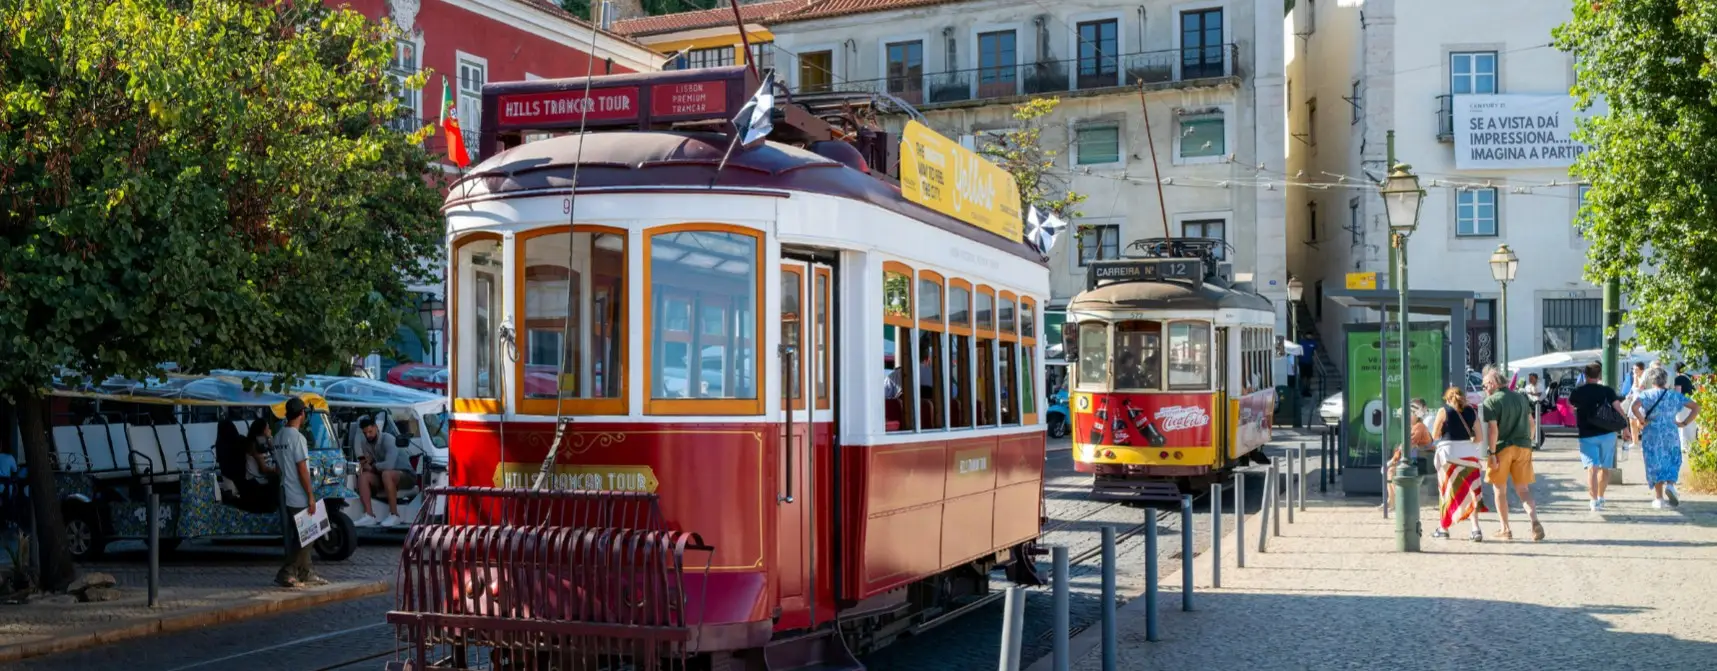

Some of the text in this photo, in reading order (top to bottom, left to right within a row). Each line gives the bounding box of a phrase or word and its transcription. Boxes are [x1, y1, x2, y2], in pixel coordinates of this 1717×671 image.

[675, 84, 703, 93] LISBON
[672, 94, 706, 103] PREMIUM
[505, 95, 631, 117] HILLS TRAMCAR TOUR
[672, 104, 706, 112] TRAMCAR
[1470, 112, 1559, 130] SE A VISTA DAÍ
[1471, 147, 1527, 160] IMAGINA
[1529, 147, 1539, 159] A
[563, 198, 570, 215] 9
[1096, 266, 1141, 277] CARREIRA
[1170, 263, 1186, 275] 12
[607, 472, 646, 491] TOUR
